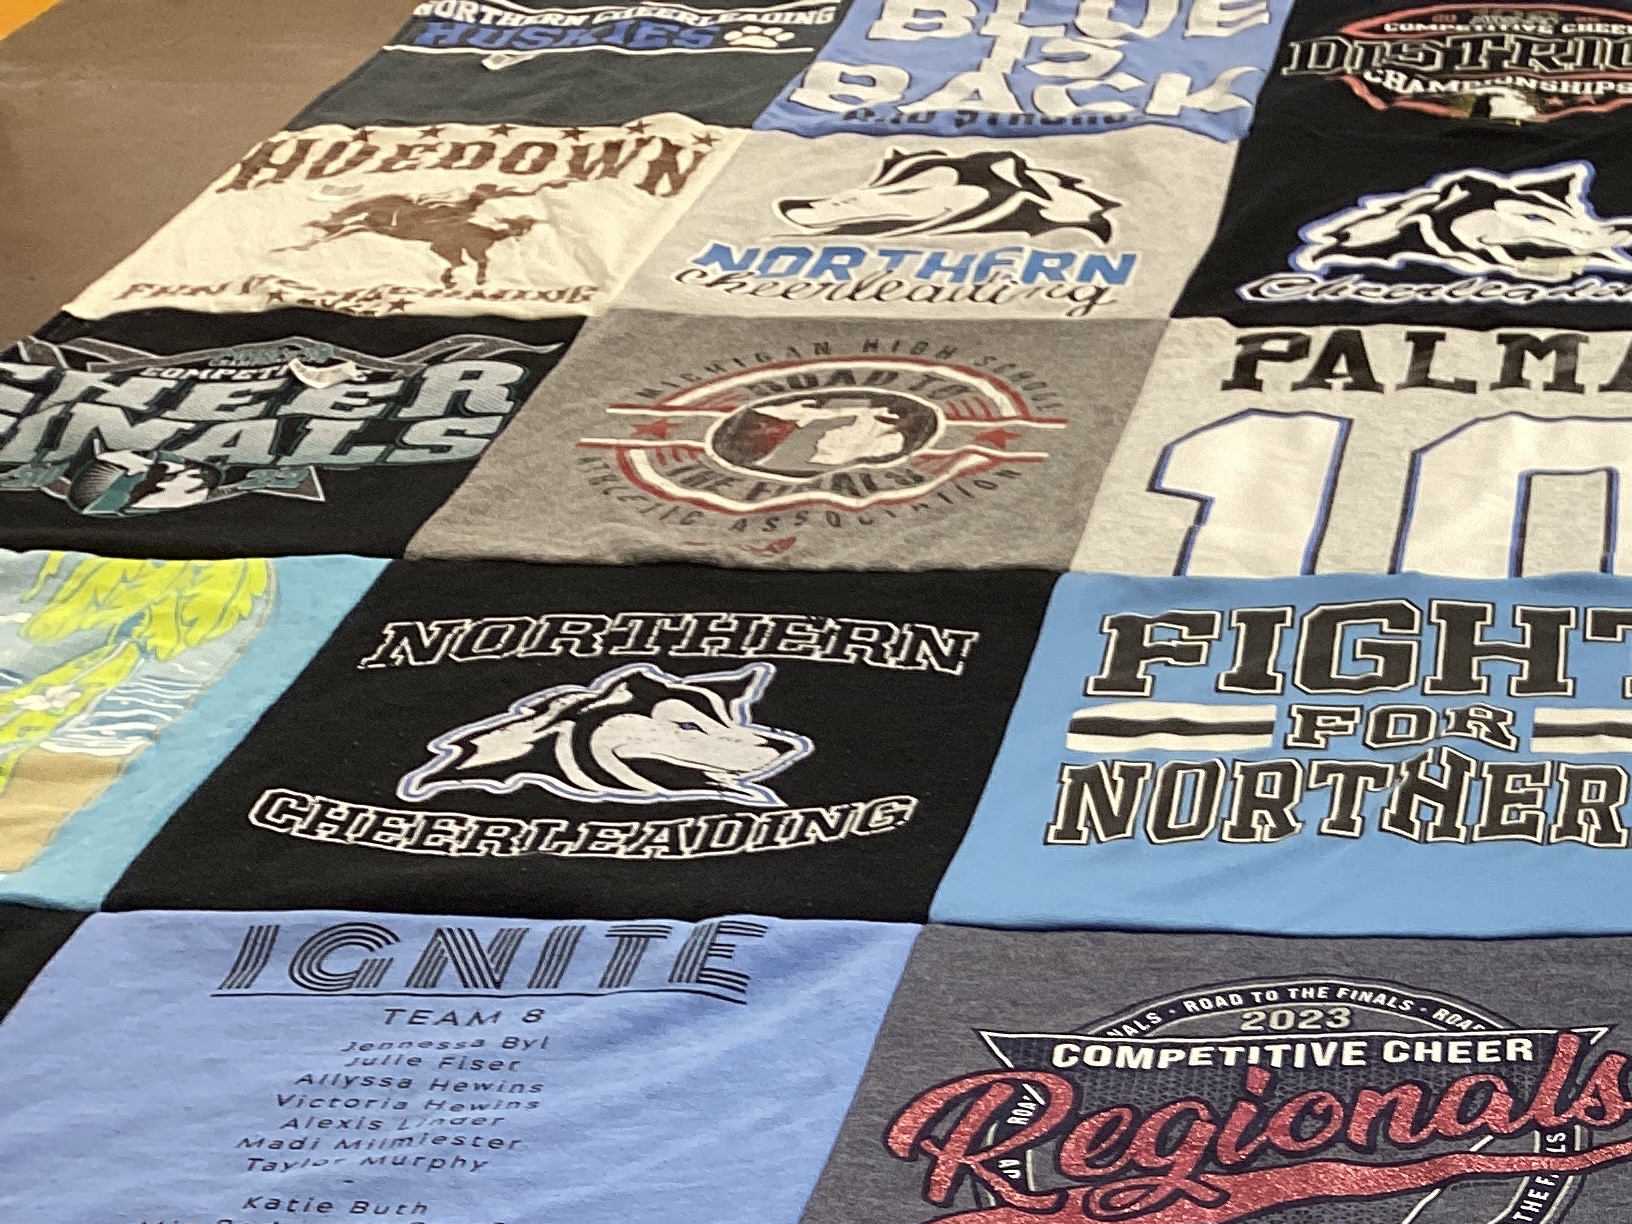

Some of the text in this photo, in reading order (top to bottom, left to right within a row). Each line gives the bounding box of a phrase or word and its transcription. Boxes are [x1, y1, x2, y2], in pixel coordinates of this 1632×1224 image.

[413, 0, 838, 26] NORTHERN CHEERLEADING
[413, 20, 721, 49] HUSKIES
[1383, 22, 1553, 35] COMPETITIVE
[790, 62, 1262, 117] BACK
[691, 241, 1139, 287] NORTHERN
[636, 340, 832, 401] MICHIGAN
[863, 338, 957, 361] HIGH
[751, 369, 969, 399] ROAD TO
[0, 400, 504, 466] INALS
[668, 464, 737, 493] THE
[357, 613, 981, 675] NORTHERN
[1284, 702, 1519, 752] FOR
[248, 788, 918, 860] CHEERLEADING
[218, 920, 770, 995] IGNITE
[1182, 992, 1243, 1014] ROAD
[1252, 988, 1279, 1004] TO
[1288, 986, 1329, 1000] THE
[1336, 987, 1415, 1012] FINALS
[383, 1007, 546, 1027] TEAM 8
[1240, 1006, 1352, 1033] 2023
[340, 1036, 551, 1052] Jennessa Byl
[1052, 1036, 1535, 1071] COMPETITIVE CHEER
[343, 1054, 523, 1072] Julie Fiser
[293, 1072, 545, 1094] Allyssa Hewins
[276, 1094, 542, 1112] Victoria Hewins
[279, 1115, 385, 1131] Alexis
[235, 1136, 321, 1151] Madi
[245, 1154, 490, 1174] Taylor Murphy
[241, 1195, 429, 1217] Katie Buth
[1513, 1189, 1550, 1222] THE
